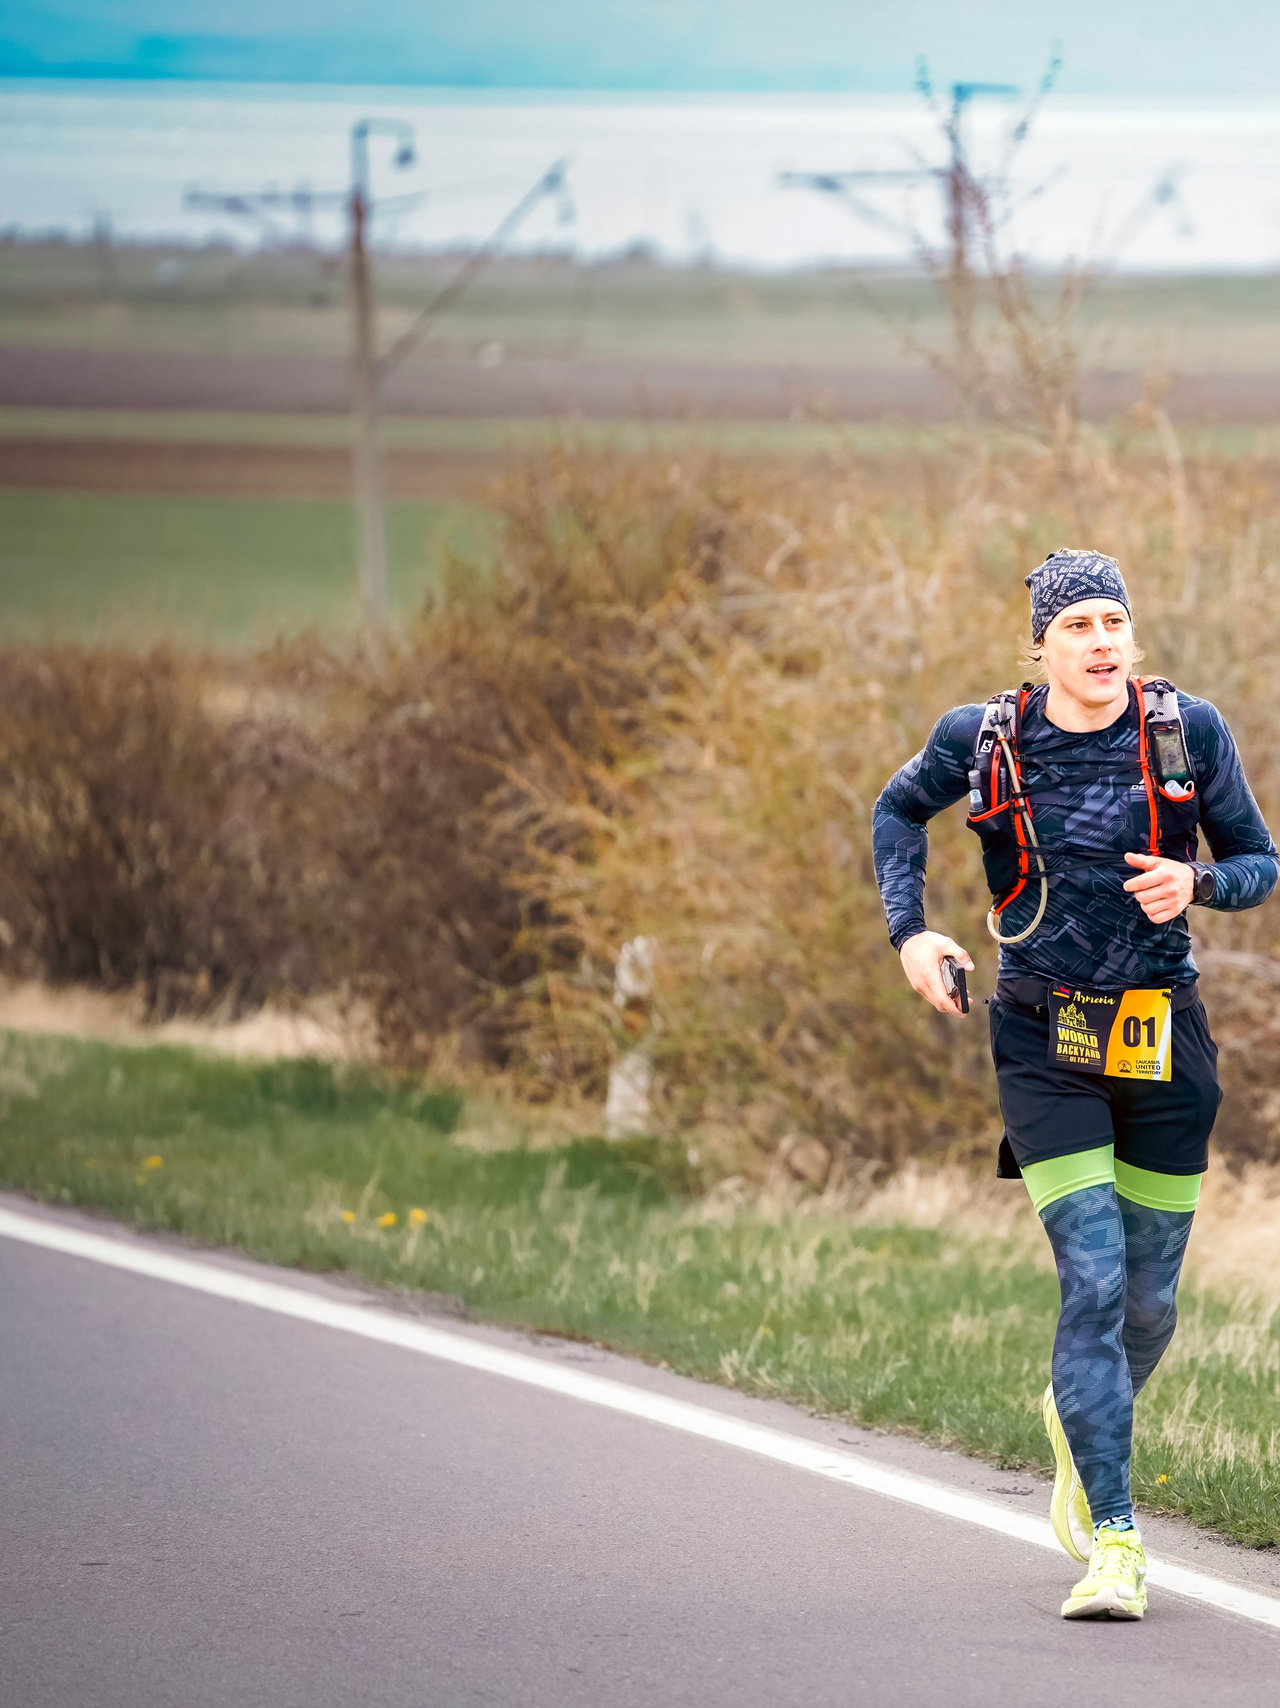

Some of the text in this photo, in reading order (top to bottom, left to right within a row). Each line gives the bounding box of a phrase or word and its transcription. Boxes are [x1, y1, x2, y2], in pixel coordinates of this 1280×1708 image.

[1066, 585, 1087, 597] Mostar
[1073, 990, 1116, 1005] Armenia
[1057, 1027, 1098, 1048] WORLD
[1123, 1016, 1156, 1048] 01
[1056, 1043, 1101, 1060] BACKYARD
[1069, 1056, 1089, 1064] ULTRA
